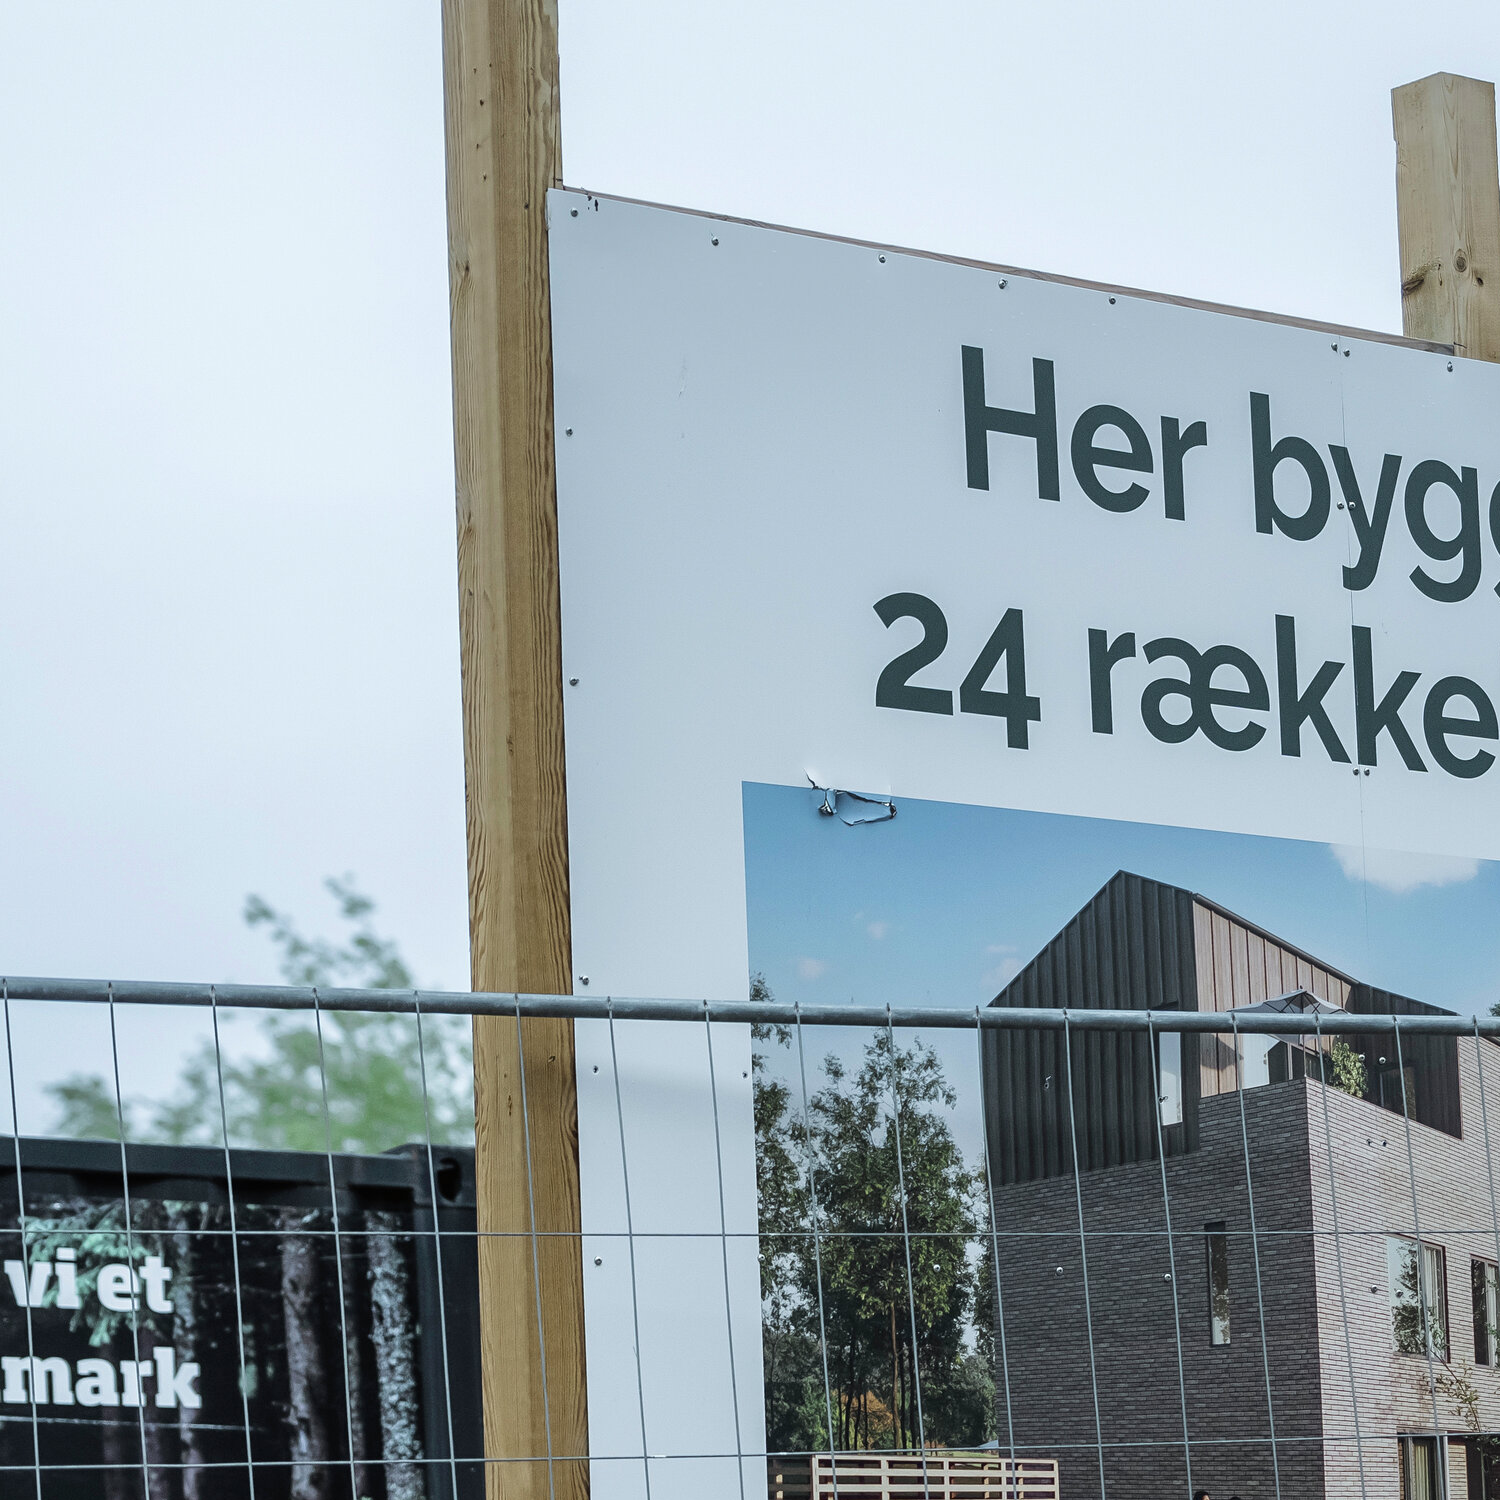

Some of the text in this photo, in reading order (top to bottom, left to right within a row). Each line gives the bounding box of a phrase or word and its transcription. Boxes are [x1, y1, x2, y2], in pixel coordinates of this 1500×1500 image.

[960, 344, 1207, 522] Her
[872, 591, 1041, 750] 24
[3, 1247, 175, 1314] vi et
[1, 1346, 202, 1409] mark
